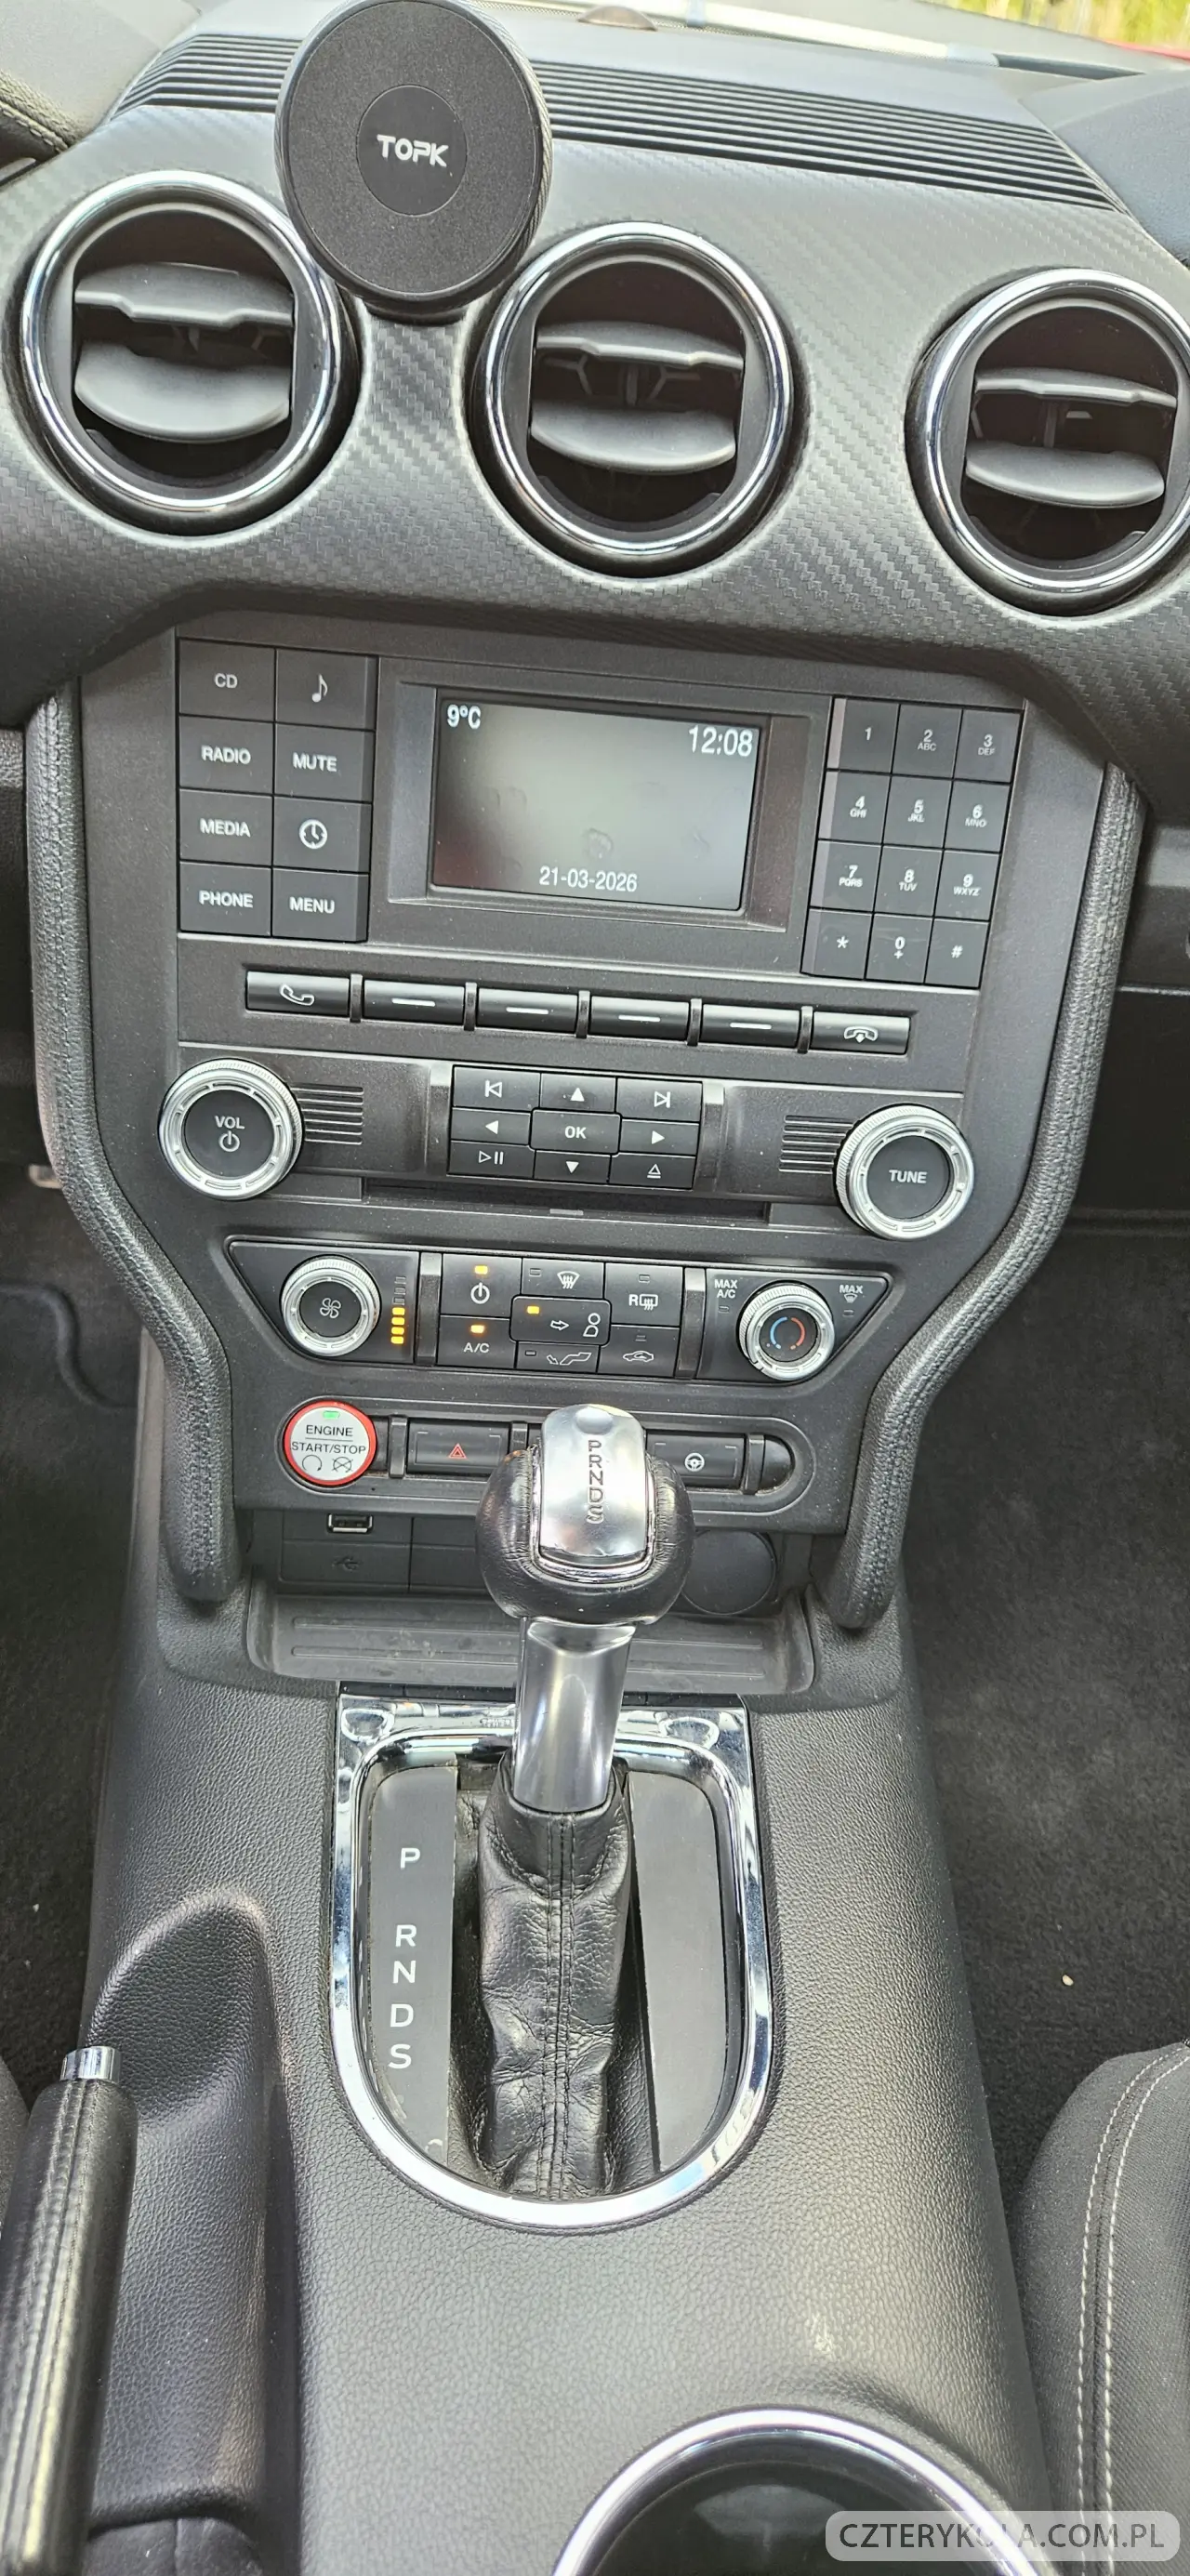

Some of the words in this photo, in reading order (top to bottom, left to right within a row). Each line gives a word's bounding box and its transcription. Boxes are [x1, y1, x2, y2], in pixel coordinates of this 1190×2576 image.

[377, 134, 449, 167] TOPK
[214, 672, 238, 689] CD
[689, 724, 753, 757] 12:08
[865, 727, 872, 741] 1
[923, 729, 933, 743] 2
[983, 733, 993, 748] 3
[917, 742, 937, 752] ABC
[977, 746, 996, 756] DEF
[201, 746, 252, 765] RADIO
[292, 752, 337, 773] MUTE
[855, 796, 866, 810] 4
[912, 799, 925, 814] 5
[849, 808, 867, 818] GHI
[907, 813, 925, 823] JKL
[972, 804, 983, 819] 6
[200, 818, 251, 838] MEDIA
[965, 817, 987, 828] MNO
[538, 865, 638, 892] 21-03-2026
[848, 865, 858, 879] 7
[904, 868, 915, 883] 8
[839, 877, 864, 888] PQRS
[898, 881, 918, 892] TUV
[961, 873, 974, 888] 9
[953, 886, 981, 897] WXYZ
[199, 890, 254, 908] PHONE
[289, 896, 336, 914] MENU
[894, 936, 906, 950] 0
[215, 1115, 245, 1129] VOL
[564, 1125, 587, 1140] OK
[888, 1169, 928, 1184] TUNE
[714, 1278, 738, 1289] MAX
[839, 1284, 864, 1296] MAX
[628, 1293, 639, 1307] R
[716, 1288, 736, 1299] A/C
[463, 1341, 490, 1354] A/C
[306, 1424, 352, 1437] ENGINE
[291, 1441, 366, 1455] START/STOP
[400, 1847, 421, 1869] P
[395, 1924, 417, 1948] R
[392, 1960, 416, 1984] N
[390, 2003, 414, 2028] D
[388, 2043, 412, 2069] S
